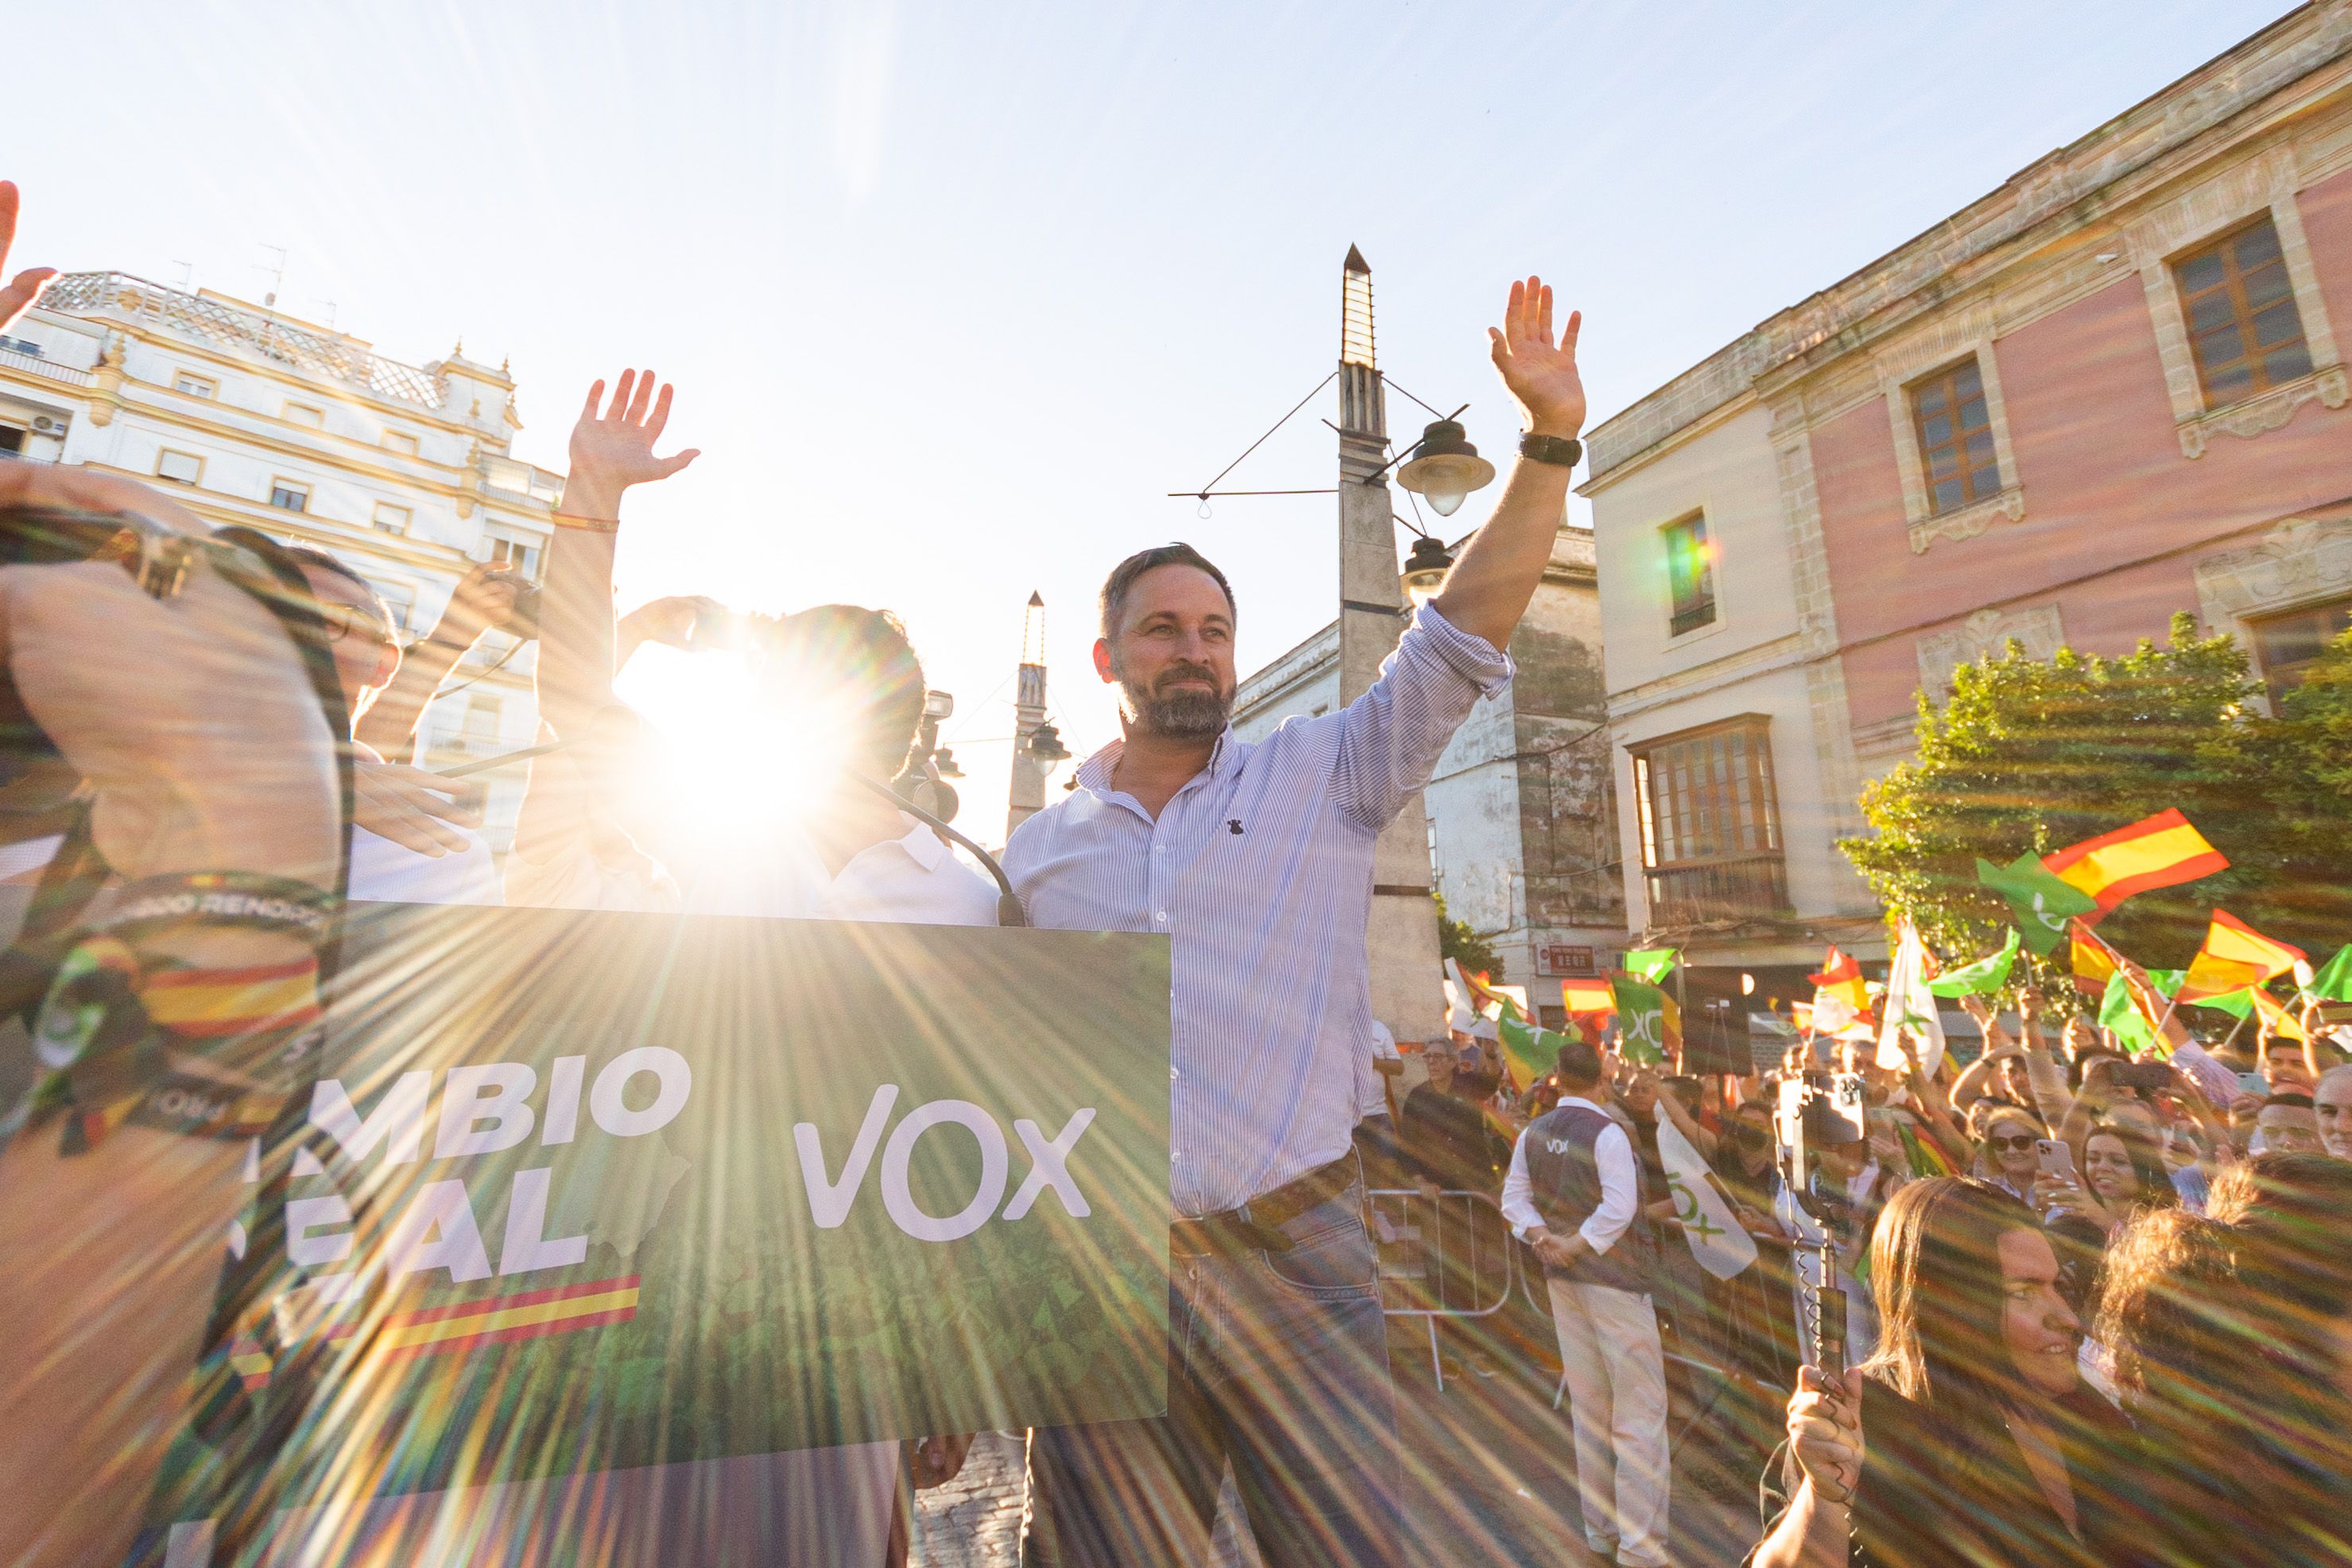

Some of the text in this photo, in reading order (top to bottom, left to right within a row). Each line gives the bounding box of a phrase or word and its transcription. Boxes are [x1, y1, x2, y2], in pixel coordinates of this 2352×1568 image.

[242, 1045, 692, 1183] MBIO
[792, 1083, 1097, 1242] VOX
[1546, 1137, 1569, 1155] VOX
[229, 1167, 589, 1305] EAL
